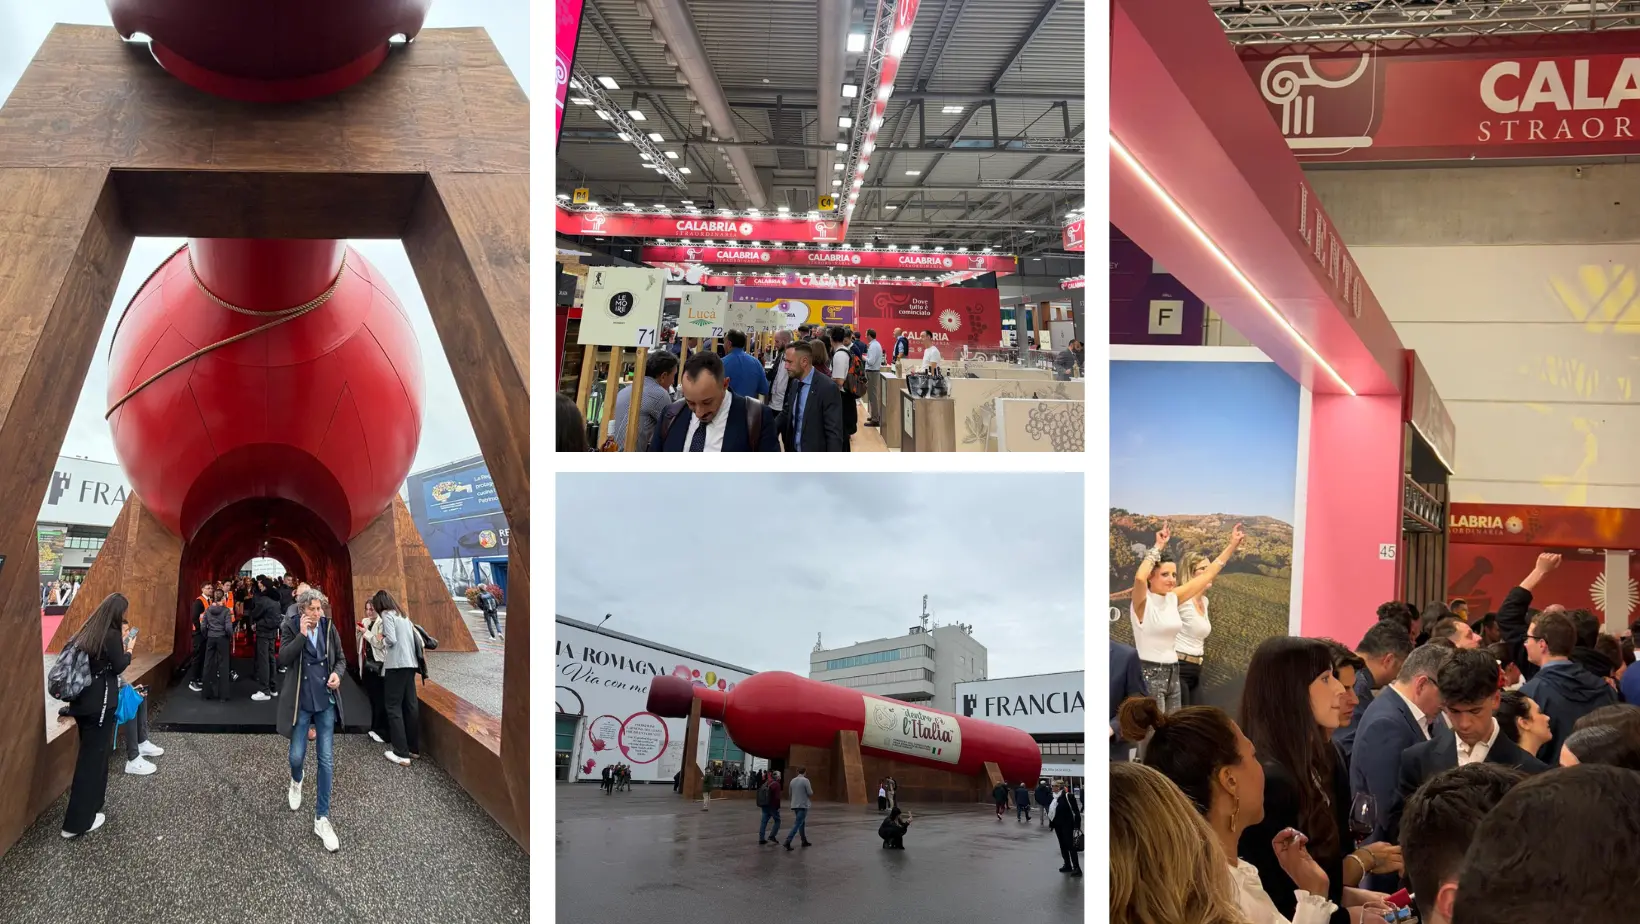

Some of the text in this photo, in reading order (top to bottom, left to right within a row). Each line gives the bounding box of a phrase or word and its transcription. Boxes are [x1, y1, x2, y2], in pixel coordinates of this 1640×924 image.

[1480, 57, 1640, 113] CALA
[1478, 116, 1634, 142] STRAOR
[676, 220, 737, 232] CALABRIA
[716, 250, 760, 259] CALABRIA
[1299, 181, 1362, 319] LENTO
[808, 253, 851, 262] CALABRIA
[898, 256, 942, 265] CALABRIA
[688, 307, 717, 319] Lucà
[898, 309, 931, 317] cominciato
[909, 304, 924, 312] tutto
[1158, 308, 1174, 327] F
[638, 328, 655, 345] 71
[711, 326, 723, 337] 72
[901, 331, 950, 341] CALRIA
[79, 480, 126, 506] FRA
[1449, 514, 1503, 530] LABRIA
[1379, 545, 1395, 558] 45
[561, 662, 600, 684] Via
[604, 679, 626, 690] con
[985, 690, 1085, 717] FRANCIA
